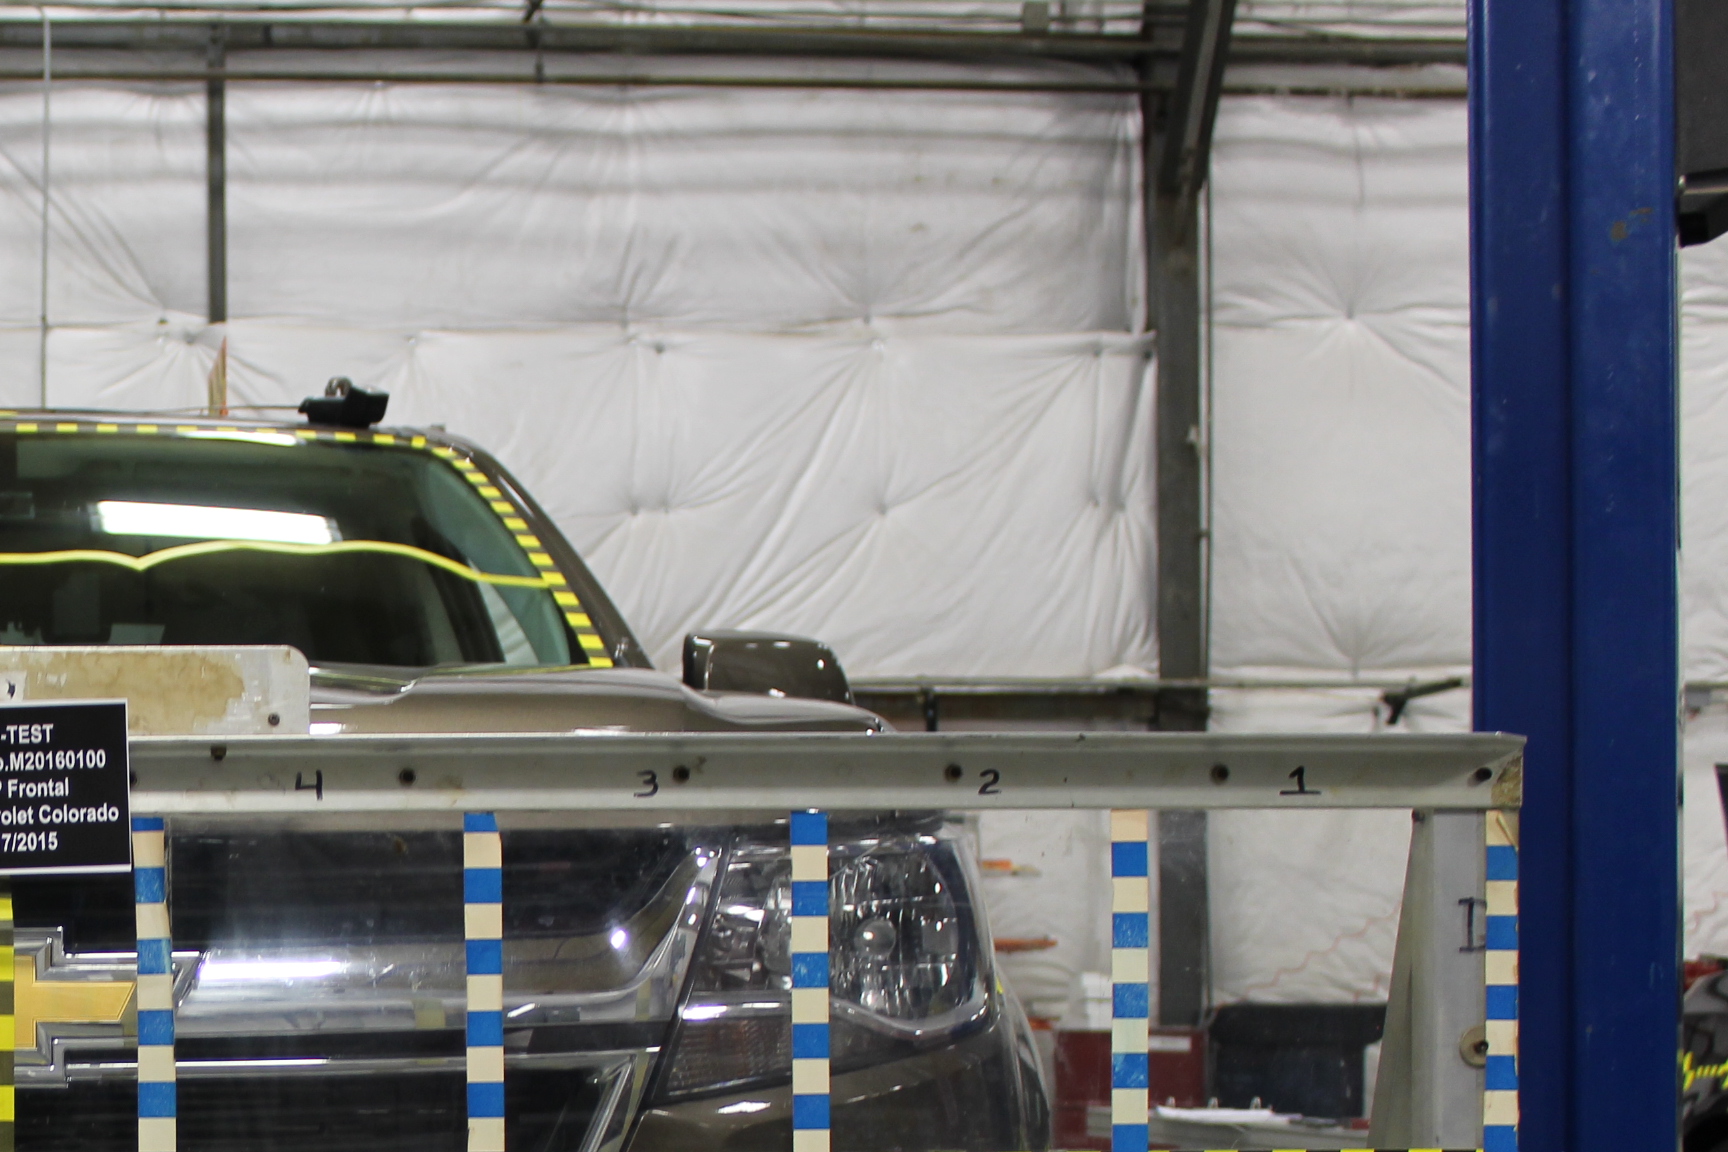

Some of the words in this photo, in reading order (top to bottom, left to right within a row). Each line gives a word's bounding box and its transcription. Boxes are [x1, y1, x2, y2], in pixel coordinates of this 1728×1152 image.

[7, 776, 70, 799] Frontal
[294, 769, 324, 801] 4
[633, 770, 660, 799] 3
[978, 768, 1002, 796] 2
[1279, 766, 1322, 796] 1
[38, 802, 120, 824] Colorado
